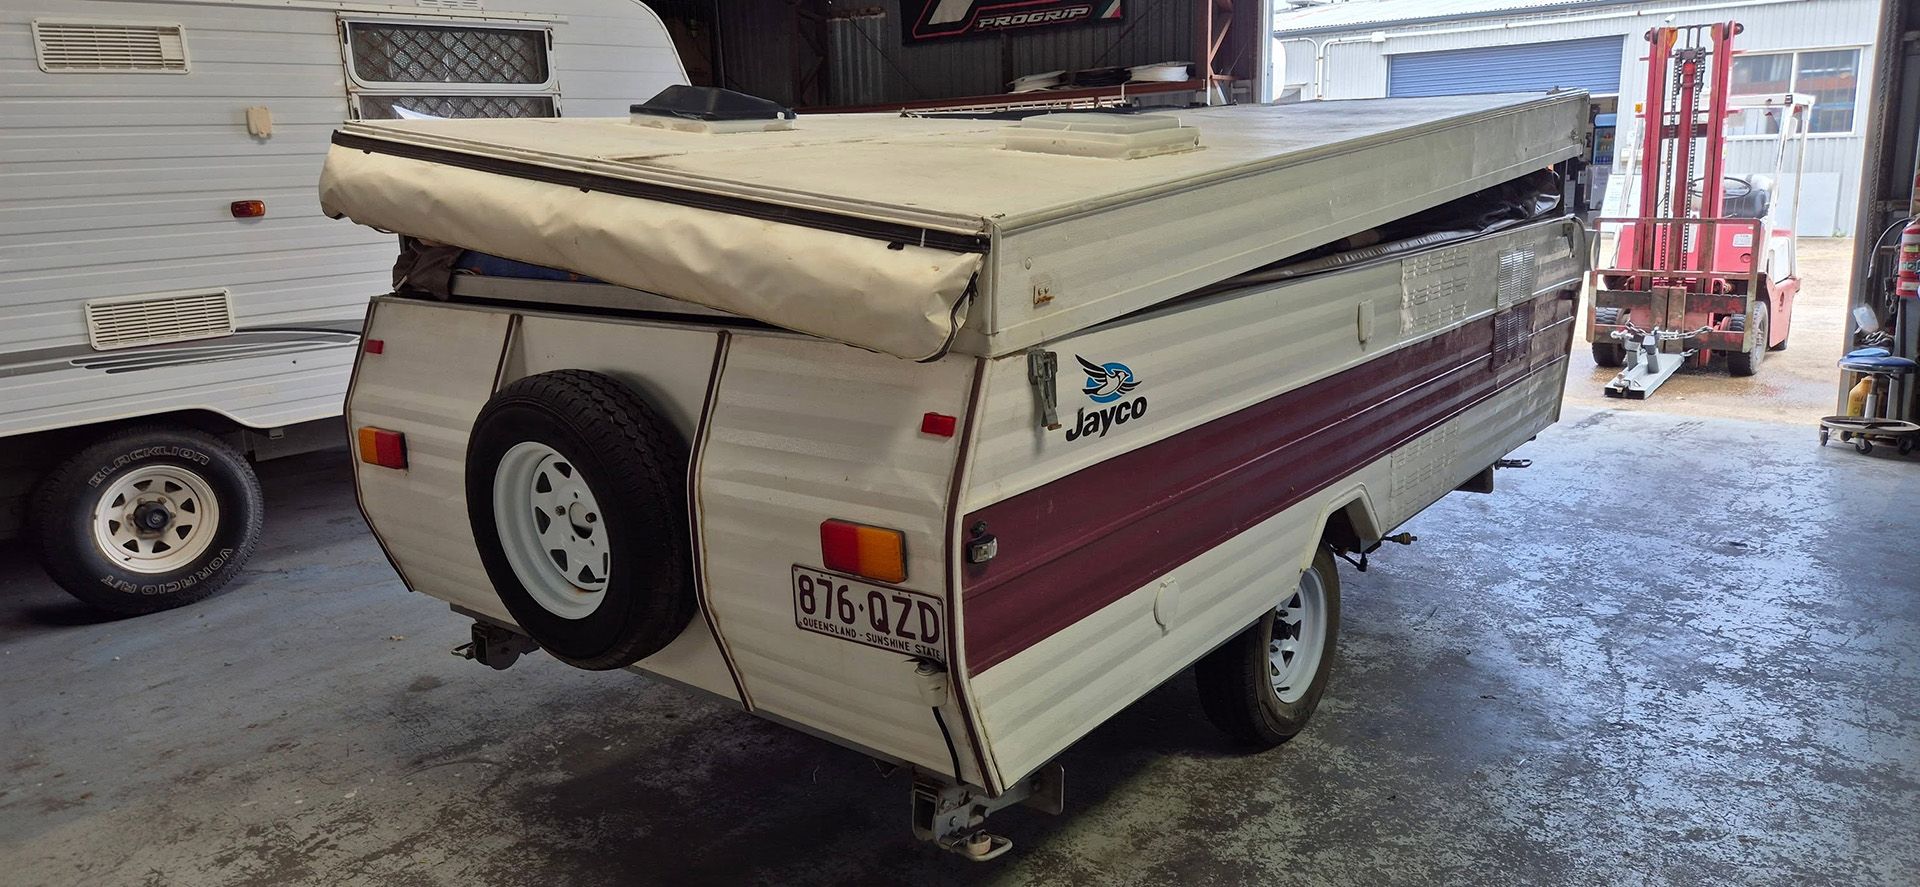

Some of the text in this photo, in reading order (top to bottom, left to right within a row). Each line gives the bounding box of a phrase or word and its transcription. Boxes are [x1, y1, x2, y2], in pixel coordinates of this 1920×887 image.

[1065, 396, 1147, 441] Jayco
[88, 446, 210, 488] BLACKLION
[141, 548, 233, 595] VORACIO
[802, 617, 857, 638] QUEENSLAND
[866, 632, 910, 651] SUNSHINE
[914, 644, 941, 661] STATE
